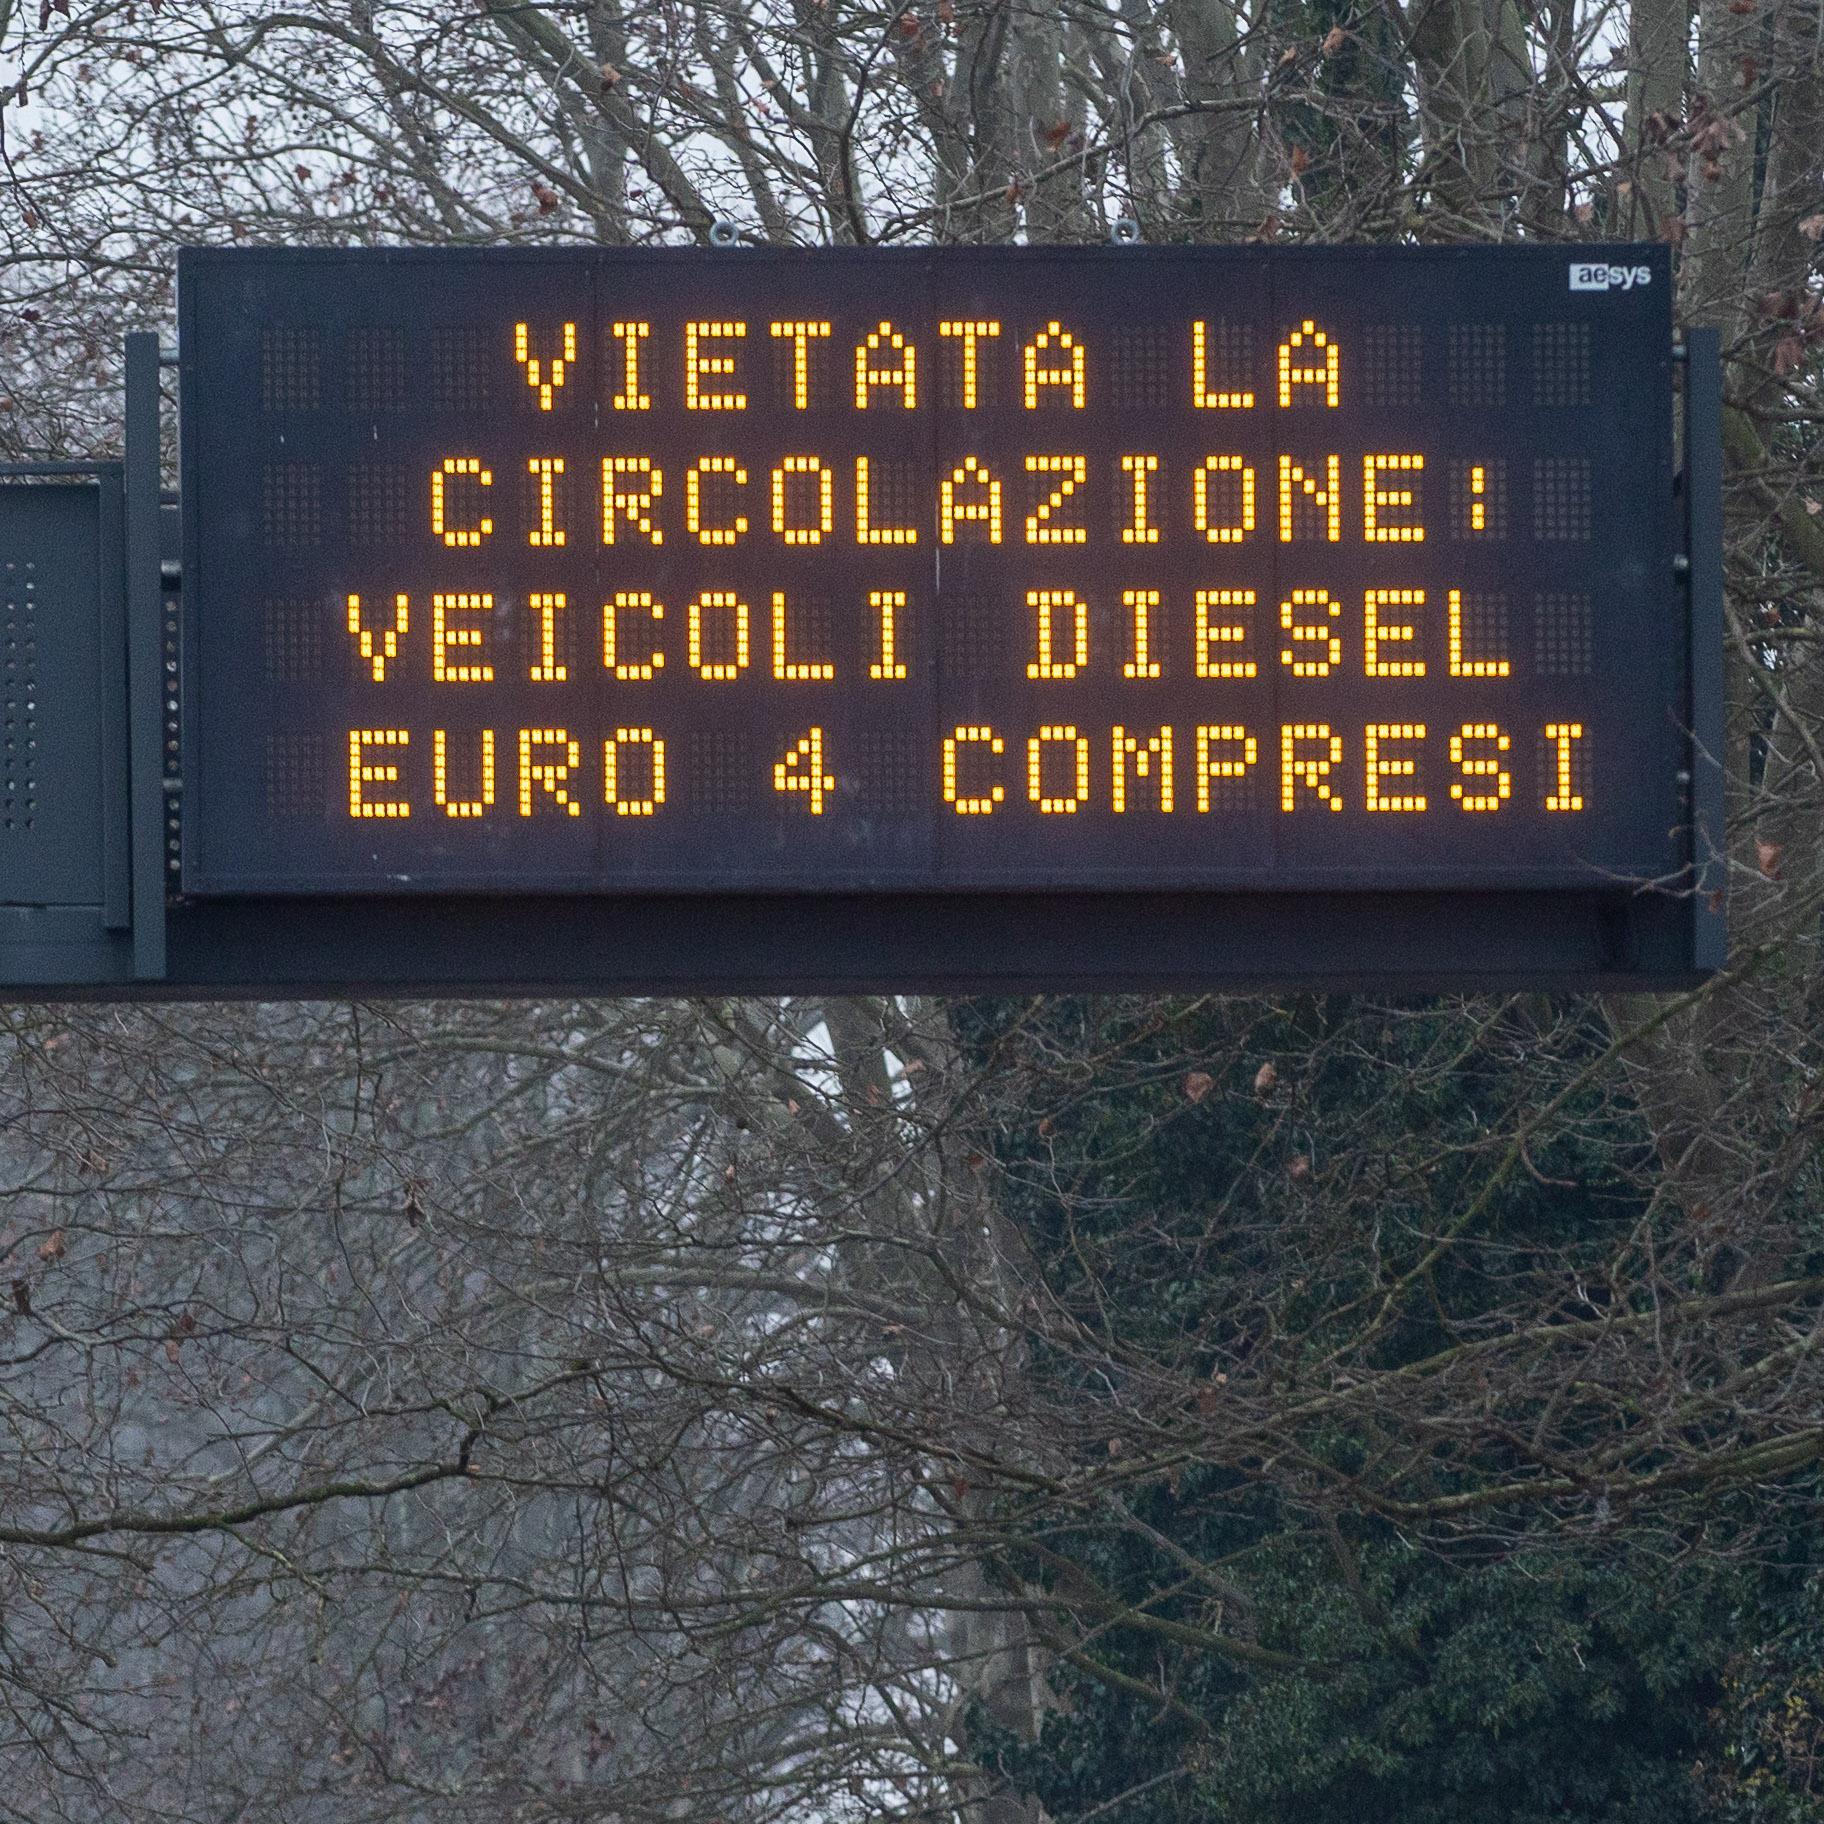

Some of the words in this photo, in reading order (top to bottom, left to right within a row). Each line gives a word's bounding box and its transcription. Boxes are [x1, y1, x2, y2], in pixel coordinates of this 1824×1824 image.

[1578, 265, 1652, 291] aesys
[513, 320, 1087, 411] VIETATA
[1192, 319, 1340, 409] LA
[430, 454, 1486, 547] CIRCOLAZIONE:
[346, 590, 908, 682] VEICOLI
[1025, 589, 1511, 680] DIESEL
[347, 727, 667, 818] EURO
[772, 726, 836, 815] 4
[942, 723, 1584, 815] COMPRESI
